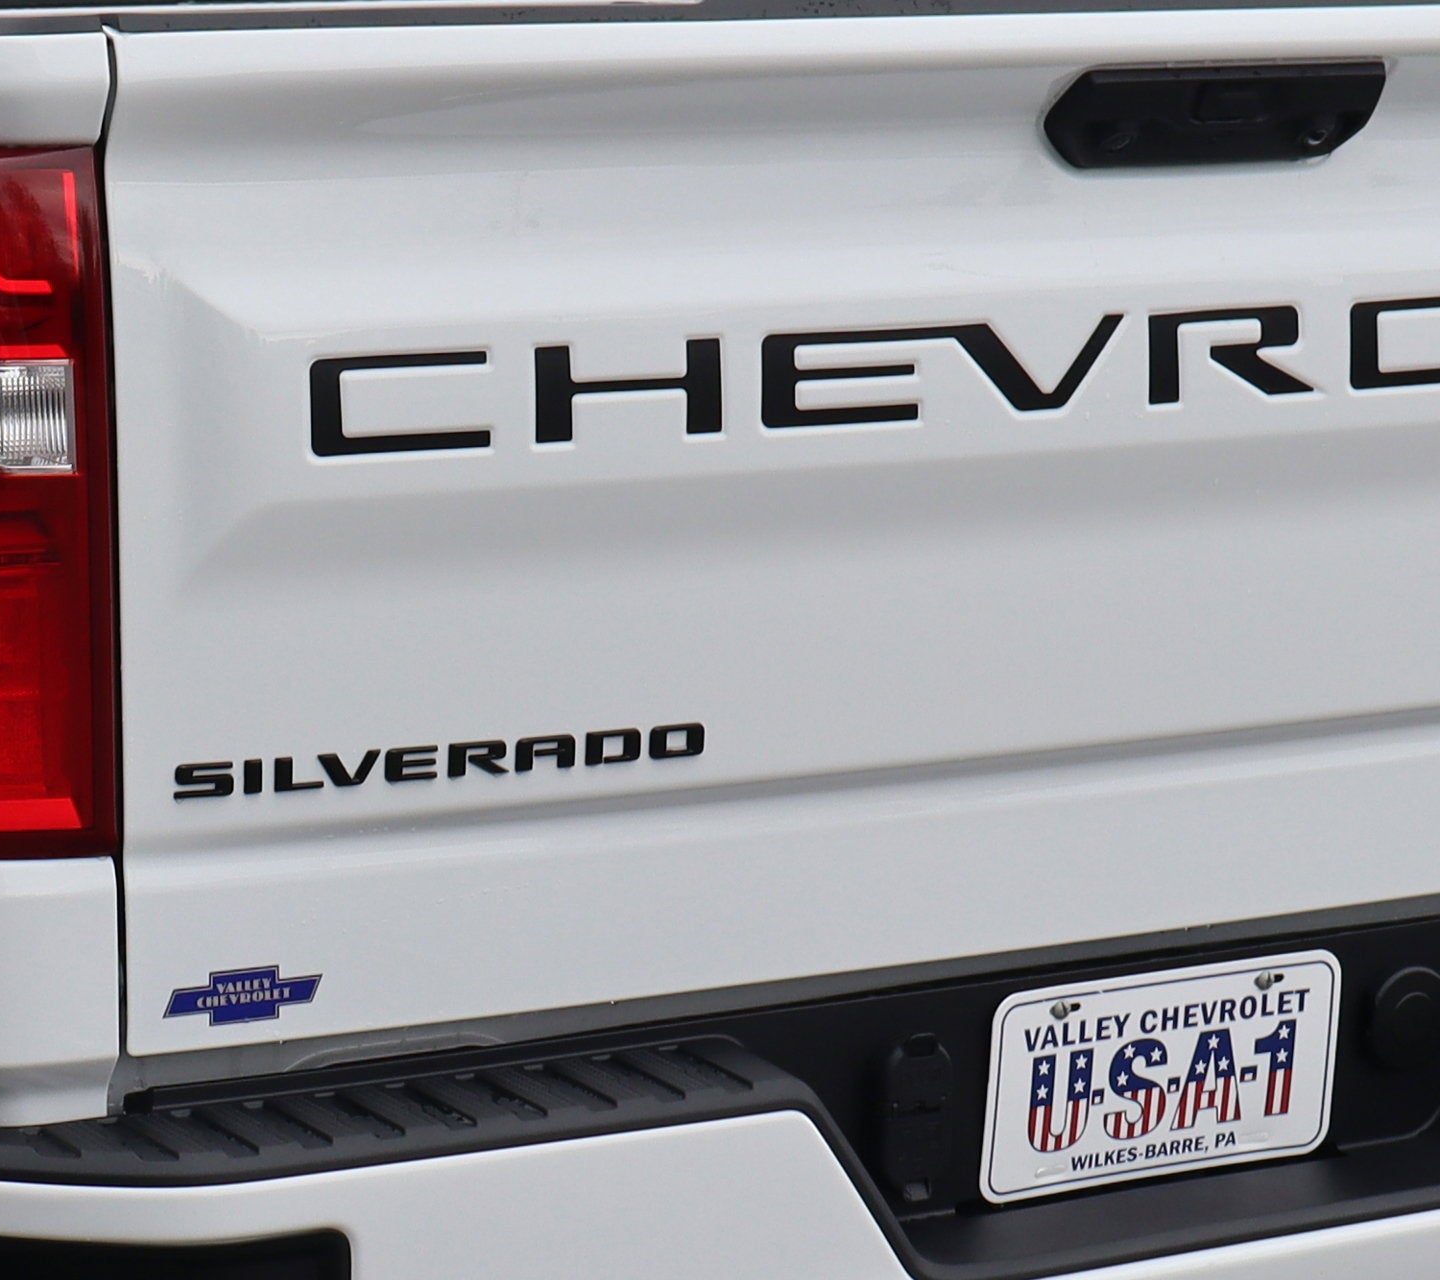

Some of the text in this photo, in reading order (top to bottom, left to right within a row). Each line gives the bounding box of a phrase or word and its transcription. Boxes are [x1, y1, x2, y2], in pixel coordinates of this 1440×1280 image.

[173, 722, 705, 800] SILVERADO
[196, 986, 291, 1009] CHEVROLET
[215, 977, 272, 995] VALLEY
[1024, 988, 1310, 1053] VALLEY CHEVROLET
[1071, 1131, 1237, 1171] WILKES-BARRE, PA
